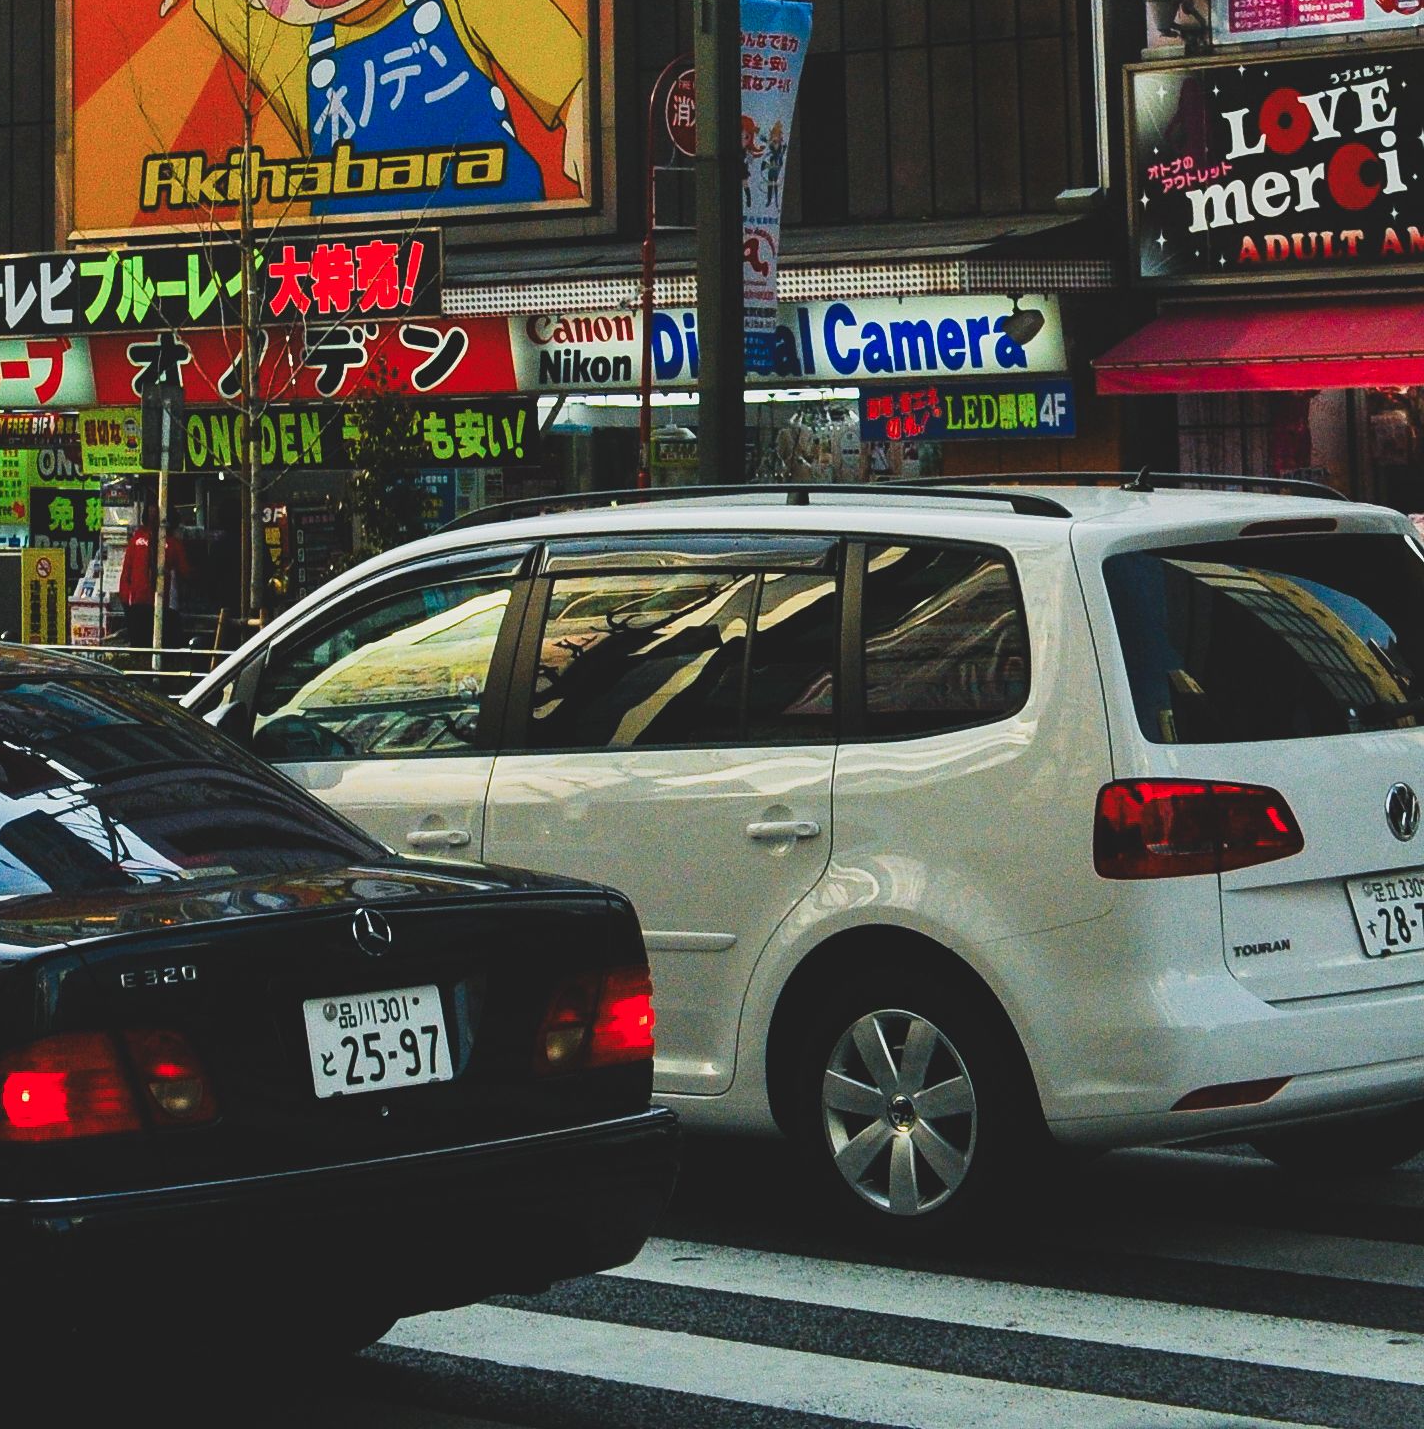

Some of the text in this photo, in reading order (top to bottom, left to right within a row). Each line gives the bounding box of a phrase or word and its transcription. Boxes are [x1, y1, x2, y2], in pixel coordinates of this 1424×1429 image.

[313, 37, 471, 142] オノデン
[1221, 78, 1398, 160] LOVE
[139, 142, 514, 211] Akihabara
[1237, 228, 1365, 264] ADULT
[268, 239, 425, 317] 大特売!
[525, 312, 636, 346] Canon
[823, 301, 1029, 376] Camera
[537, 349, 633, 386] Nikon
[187, 411, 324, 466] ONDEN
[1039, 392, 1067, 428] 4F
[1232, 938, 1292, 958] TOURAN
[340, 1024, 439, 1086] 25-97
